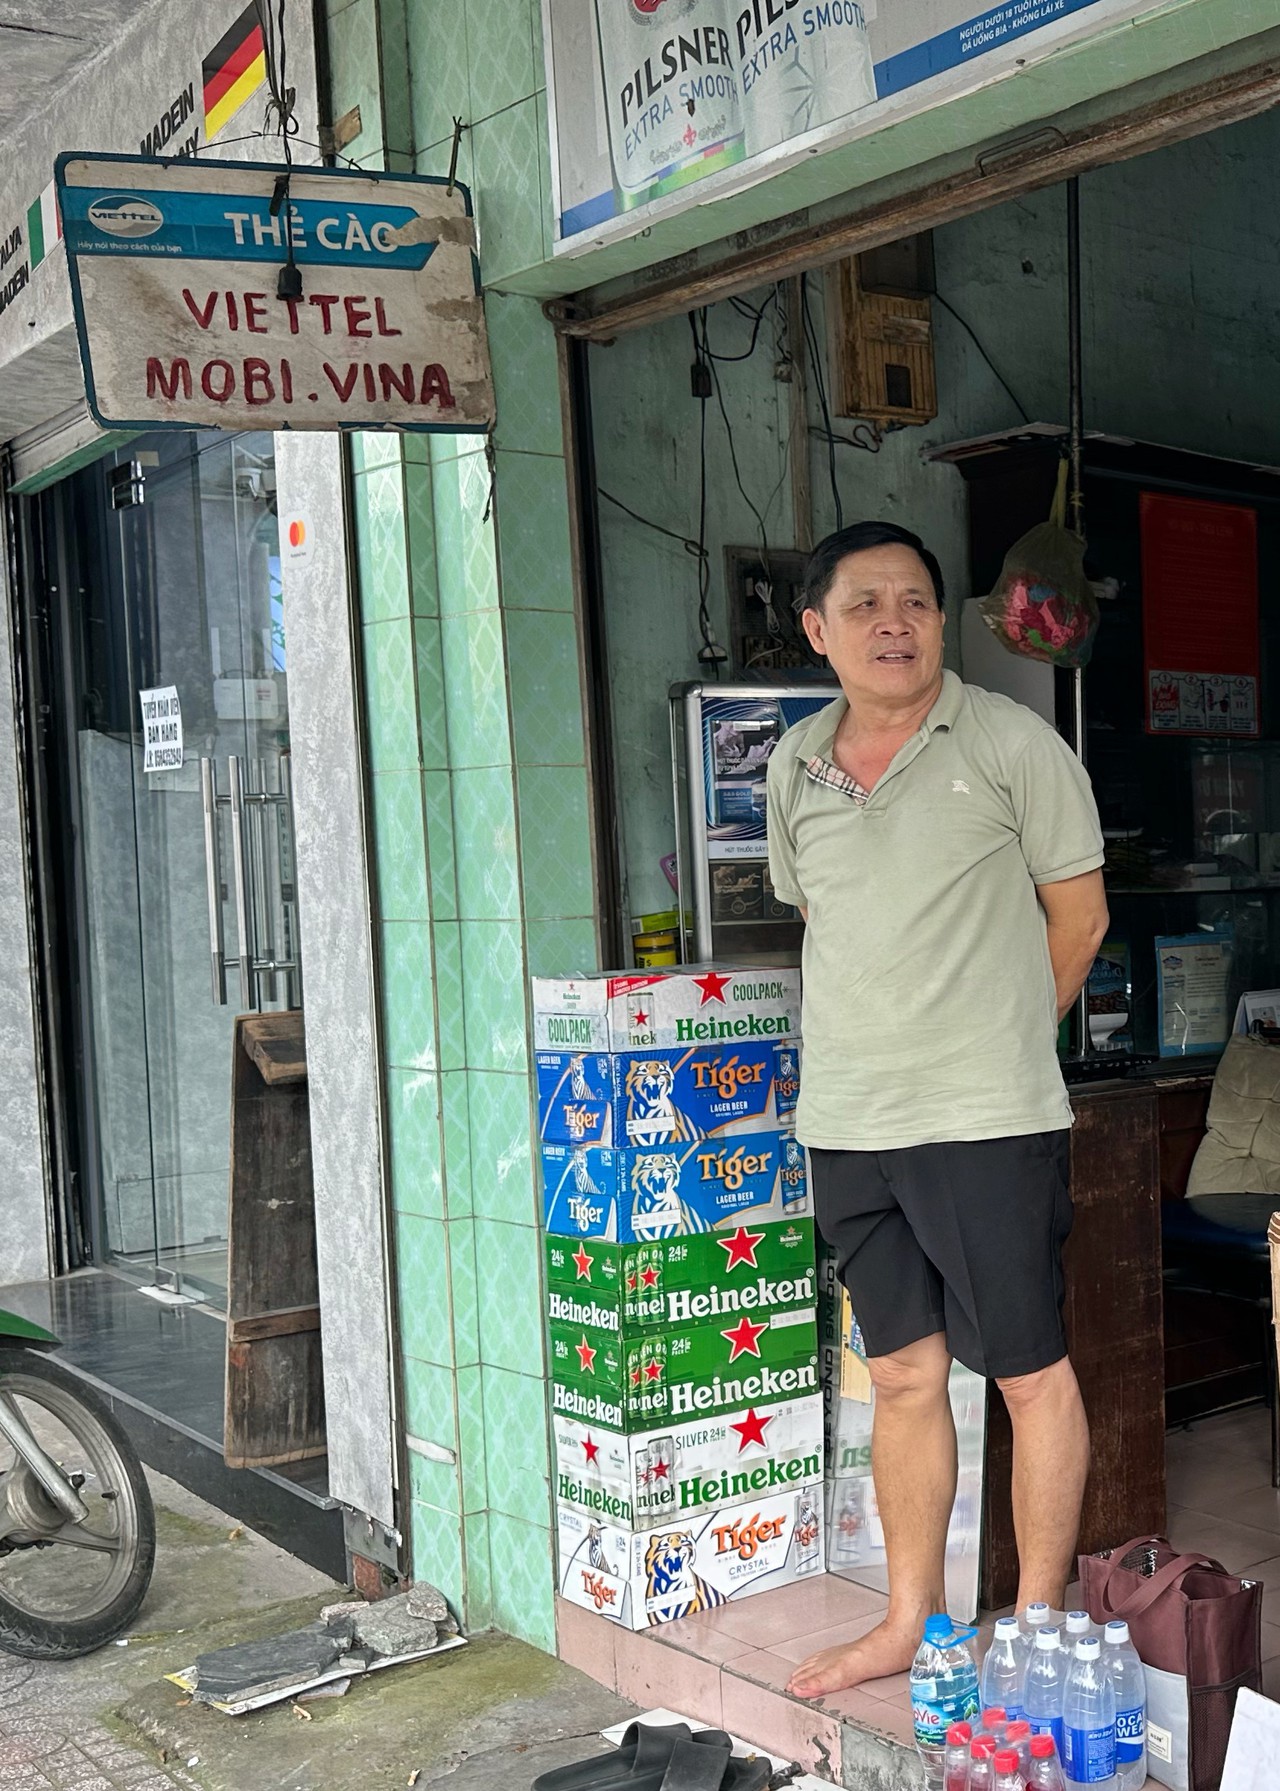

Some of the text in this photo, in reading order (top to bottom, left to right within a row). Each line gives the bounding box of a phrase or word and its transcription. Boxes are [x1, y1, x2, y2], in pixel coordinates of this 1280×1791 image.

[736, 0, 800, 60] PIL
[960, 23, 984, 40] NGƯỜI
[985, 13, 1004, 29] DƯỚI
[1005, 9, 1012, 19] 18
[961, 41, 972, 52] ĐÃ
[973, 31, 994, 46] UỐNG
[995, 27, 1007, 40] BIA
[1012, 10, 1040, 29] KHÔNG
[1041, 3, 1053, 17] LÁI
[1054, 0, 1064, 11] XE
[742, 0, 867, 95] EXTRA SMOOTH
[620, 27, 734, 129] PILSNER
[625, 94, 674, 161] EXTRA
[679, 75, 739, 107] SMOOTH
[91, 212, 160, 220] VIETTEL
[224, 206, 400, 253] THẺ CÀO
[0, 225, 22, 270] ALYA
[182, 288, 402, 338] VIETTEL
[733, 982, 783, 1001] COOLPACK
[548, 1018, 592, 1043] COOLPACK
[675, 1014, 791, 1041] Heineken
[690, 1056, 766, 1099] Tiger
[774, 1077, 800, 1097] Tige
[563, 1103, 599, 1137] Tiger
[710, 1101, 748, 1113] LAGER BEER
[696, 1145, 773, 1190] Tiger
[567, 1197, 604, 1231] Tiger
[716, 1191, 754, 1204] LAGER BEER
[669, 1246, 681, 1257] 24
[549, 1293, 619, 1331] Heineken
[667, 1278, 814, 1322] Heineken
[671, 1340, 684, 1350] 24
[553, 1383, 622, 1427] Heineken
[670, 1367, 817, 1415] Heineken
[675, 1430, 709, 1450] SILVER
[559, 1474, 631, 1521] Heineken
[679, 1454, 820, 1509] Heineken
[710, 1512, 788, 1561] Tiger
[729, 1558, 770, 1576] CRYSTAL
[581, 1569, 617, 1610] Tiger
